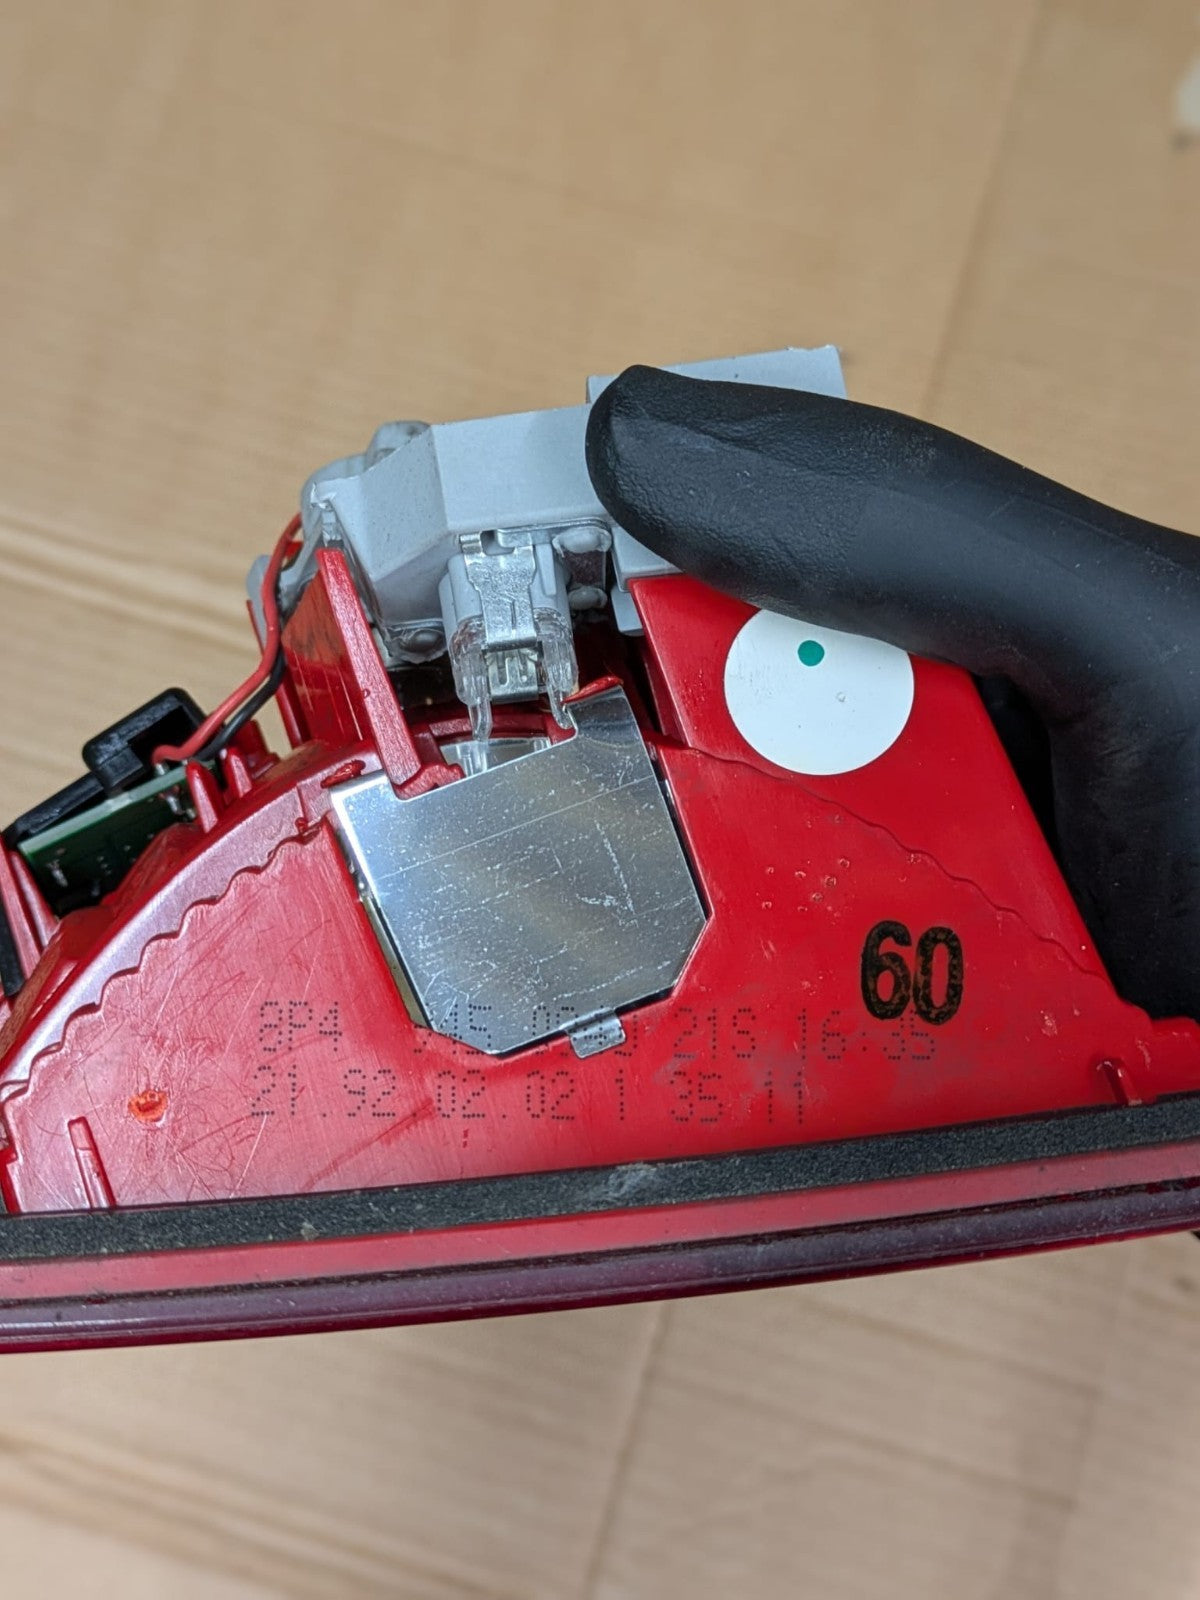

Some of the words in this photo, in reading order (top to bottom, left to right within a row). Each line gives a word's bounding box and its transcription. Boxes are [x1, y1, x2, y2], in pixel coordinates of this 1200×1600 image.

[860, 919, 965, 1026] 60
[257, 999, 344, 1053] 8P4
[668, 1070, 724, 1123] 35
